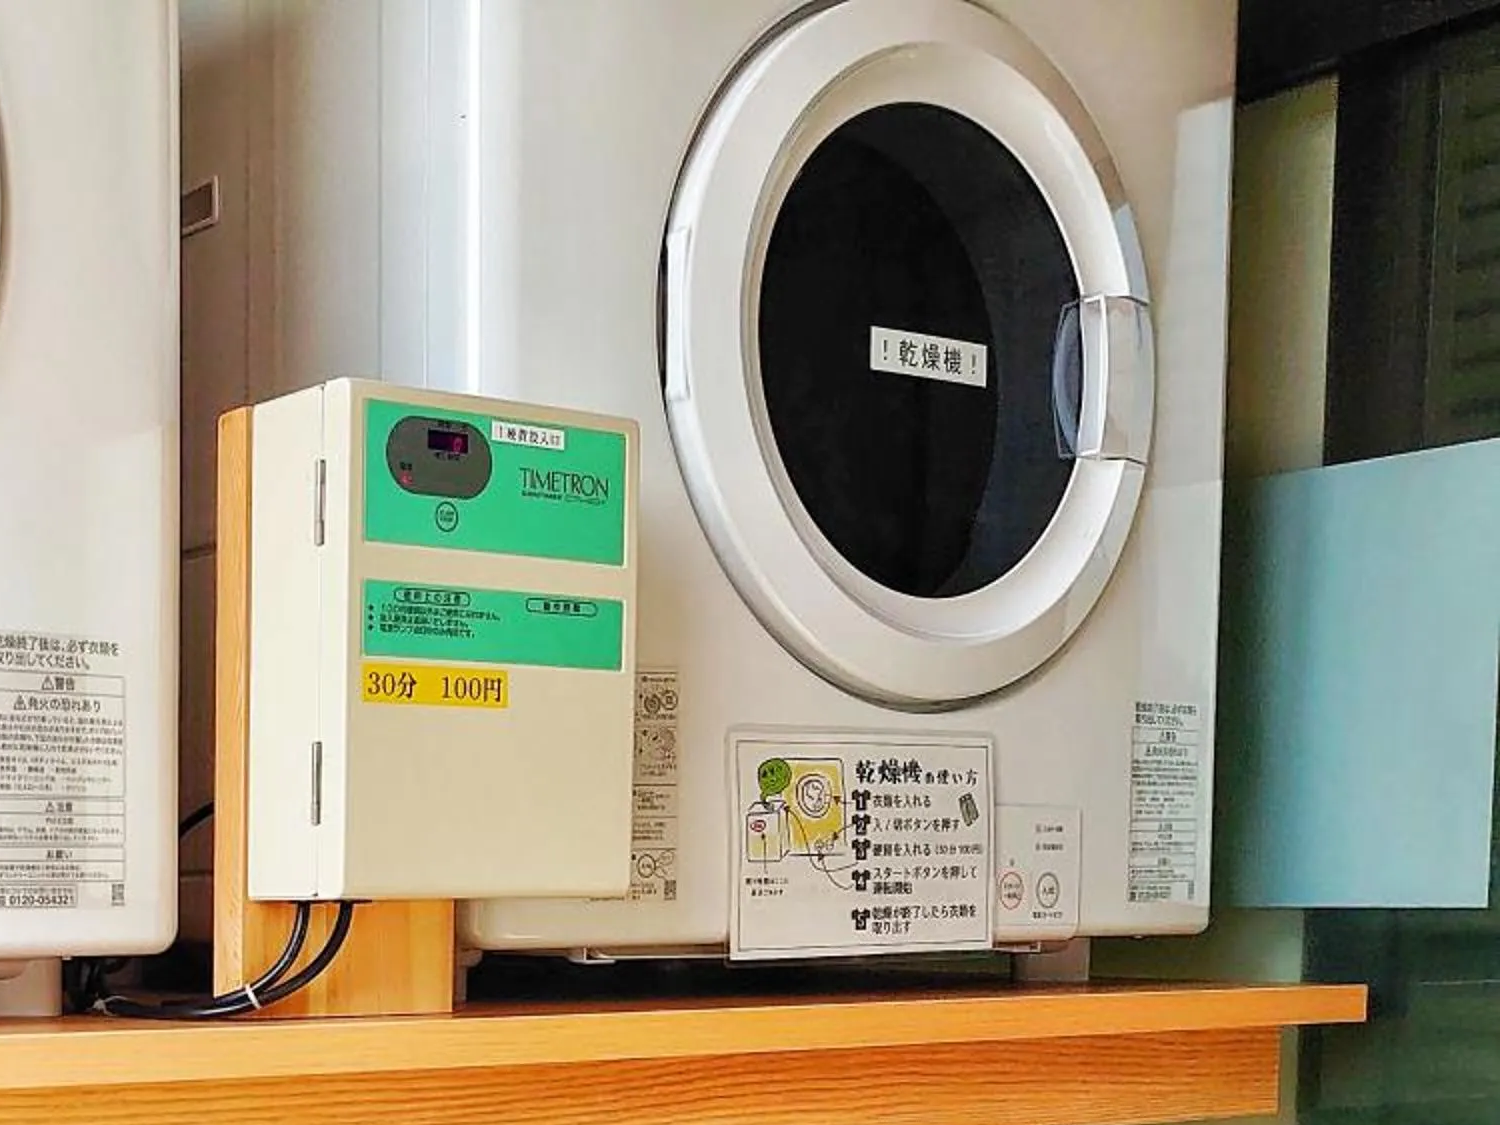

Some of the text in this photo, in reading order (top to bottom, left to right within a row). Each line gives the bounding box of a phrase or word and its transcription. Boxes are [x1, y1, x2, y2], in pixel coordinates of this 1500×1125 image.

[519, 467, 609, 499] TIMETRON
[367, 672, 502, 702] 30分 100円
[855, 758, 979, 786] 乾燥機の使い方
[873, 865, 978, 880] スタートボタンを押して
